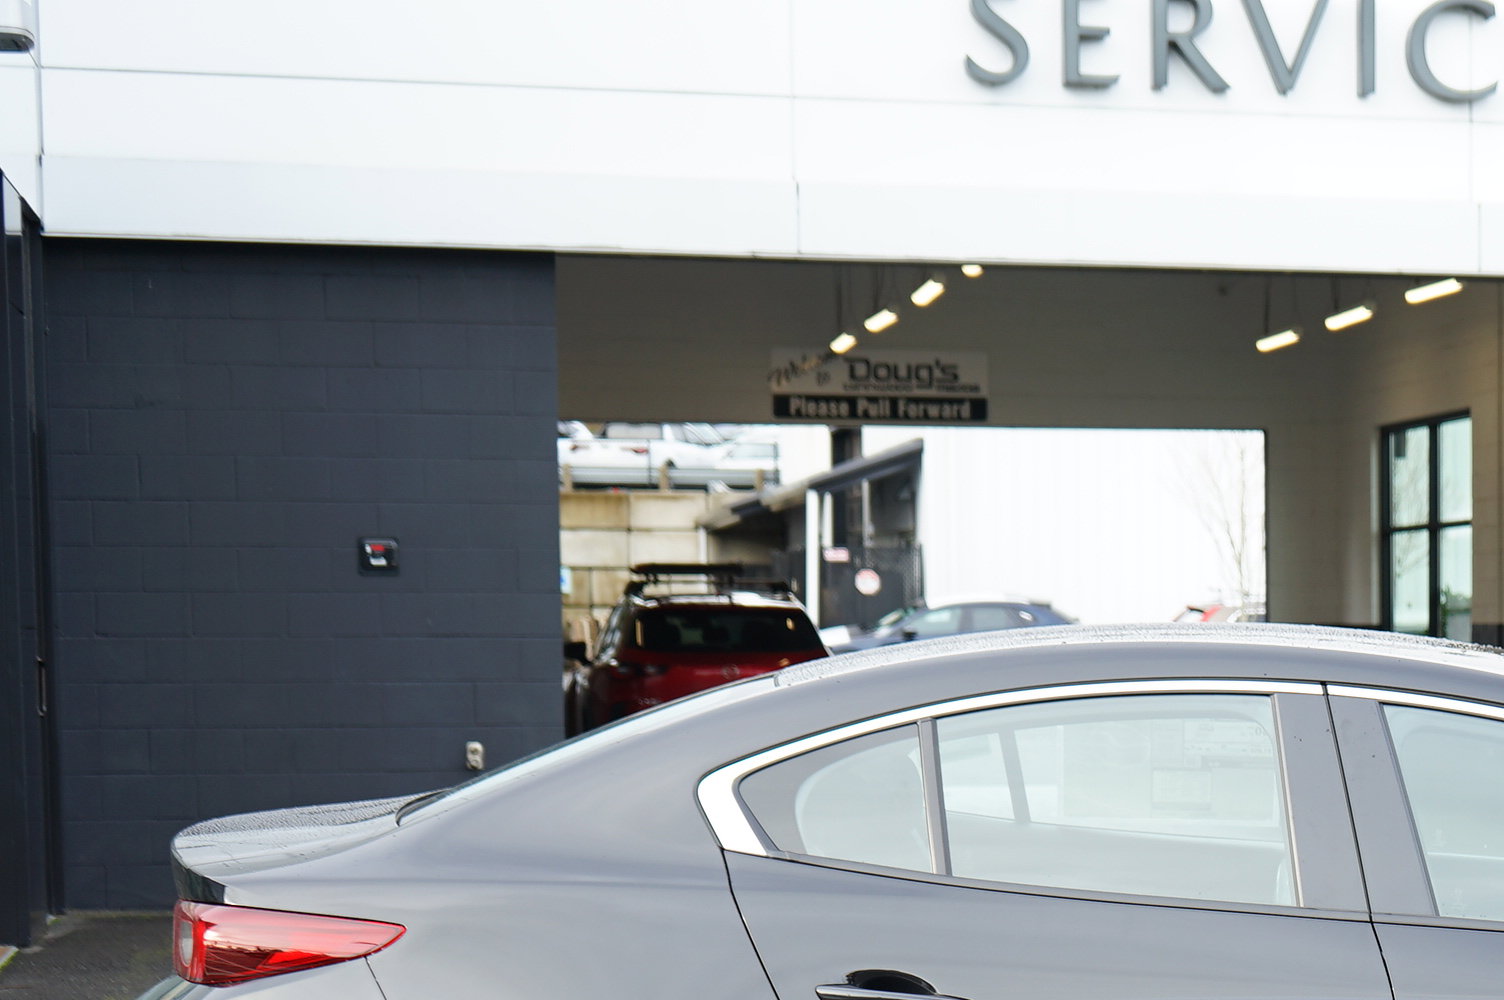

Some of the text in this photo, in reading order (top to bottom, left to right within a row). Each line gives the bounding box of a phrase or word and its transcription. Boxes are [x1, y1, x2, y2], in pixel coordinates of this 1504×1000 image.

[844, 357, 960, 389] Doug's
[789, 396, 972, 420] Please Pull Forward
